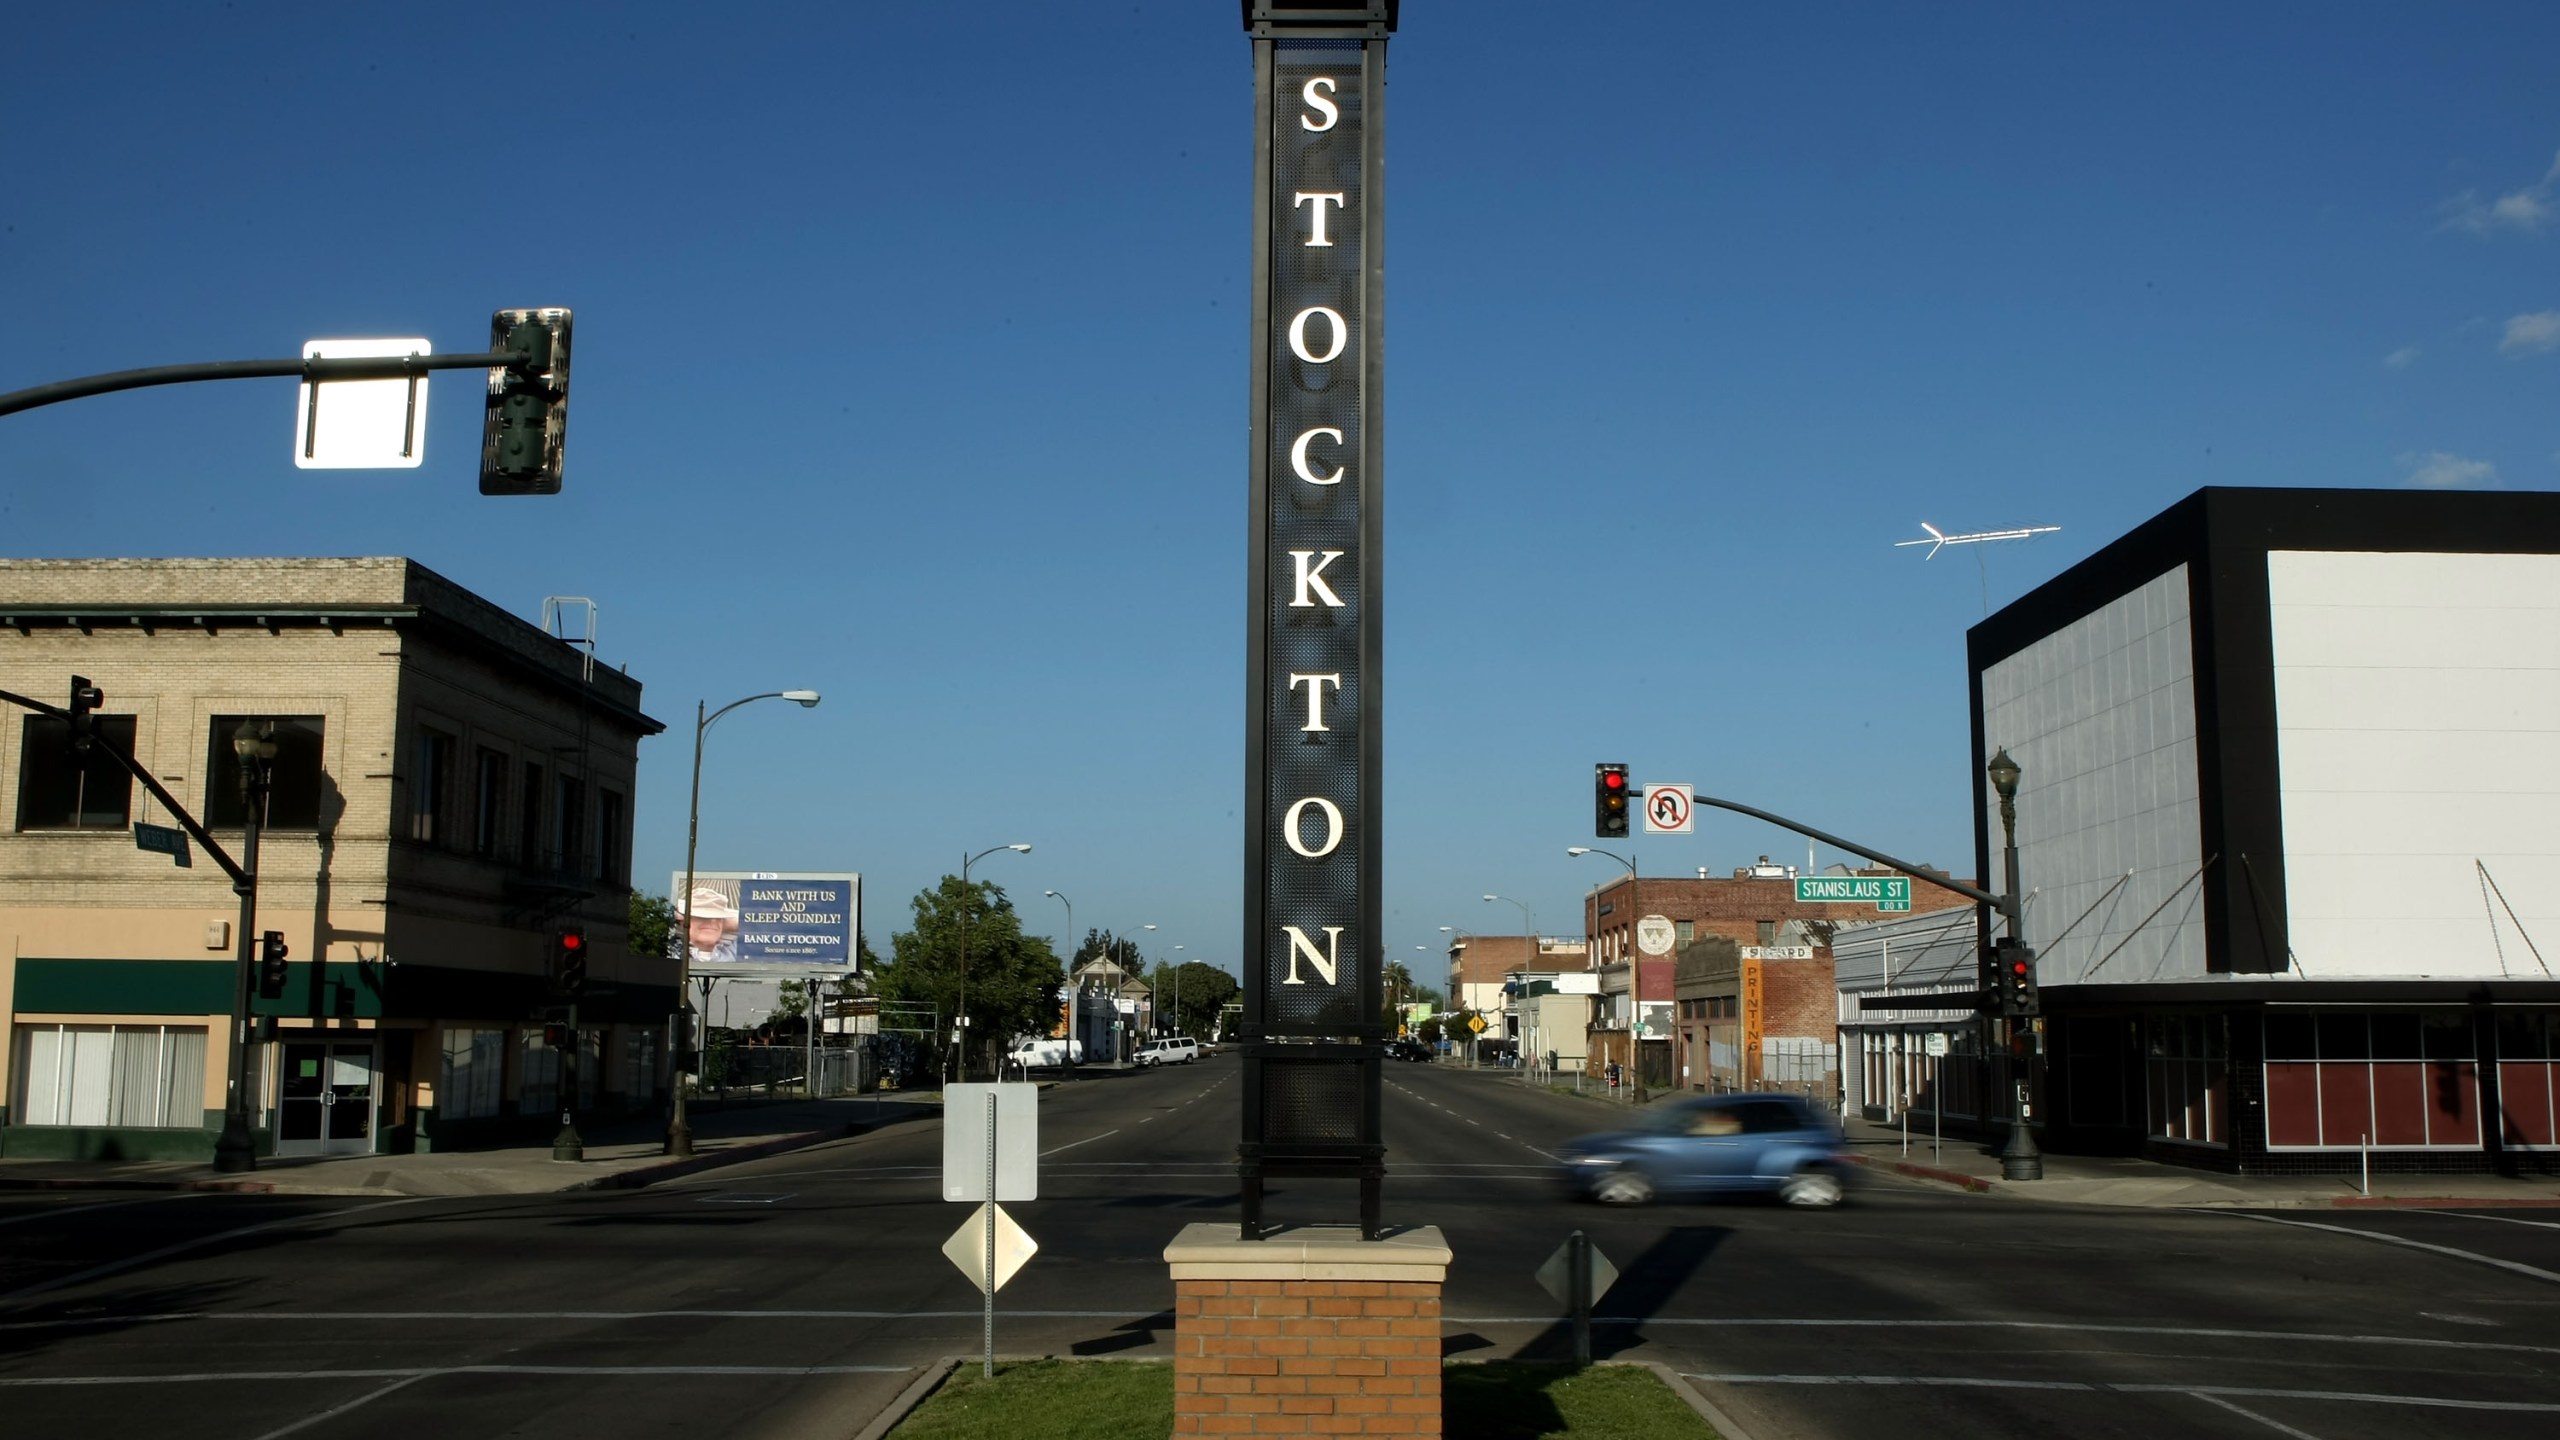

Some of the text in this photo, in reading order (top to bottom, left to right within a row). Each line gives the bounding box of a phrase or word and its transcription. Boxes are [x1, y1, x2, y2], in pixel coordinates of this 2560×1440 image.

[1282, 77, 1347, 986] STOCKTON
[1802, 881, 1903, 897] STANISLAUS ST
[752, 890, 836, 902] BANK WITH US
[780, 902, 806, 912] AND
[1897, 902, 1904, 910] N
[744, 912, 841, 924] SLEEP SOUNDLY!
[744, 934, 841, 945] BANK OF STOCKTON
[764, 946, 785, 954] Secure
[1747, 967, 1759, 1052] PRINTING
